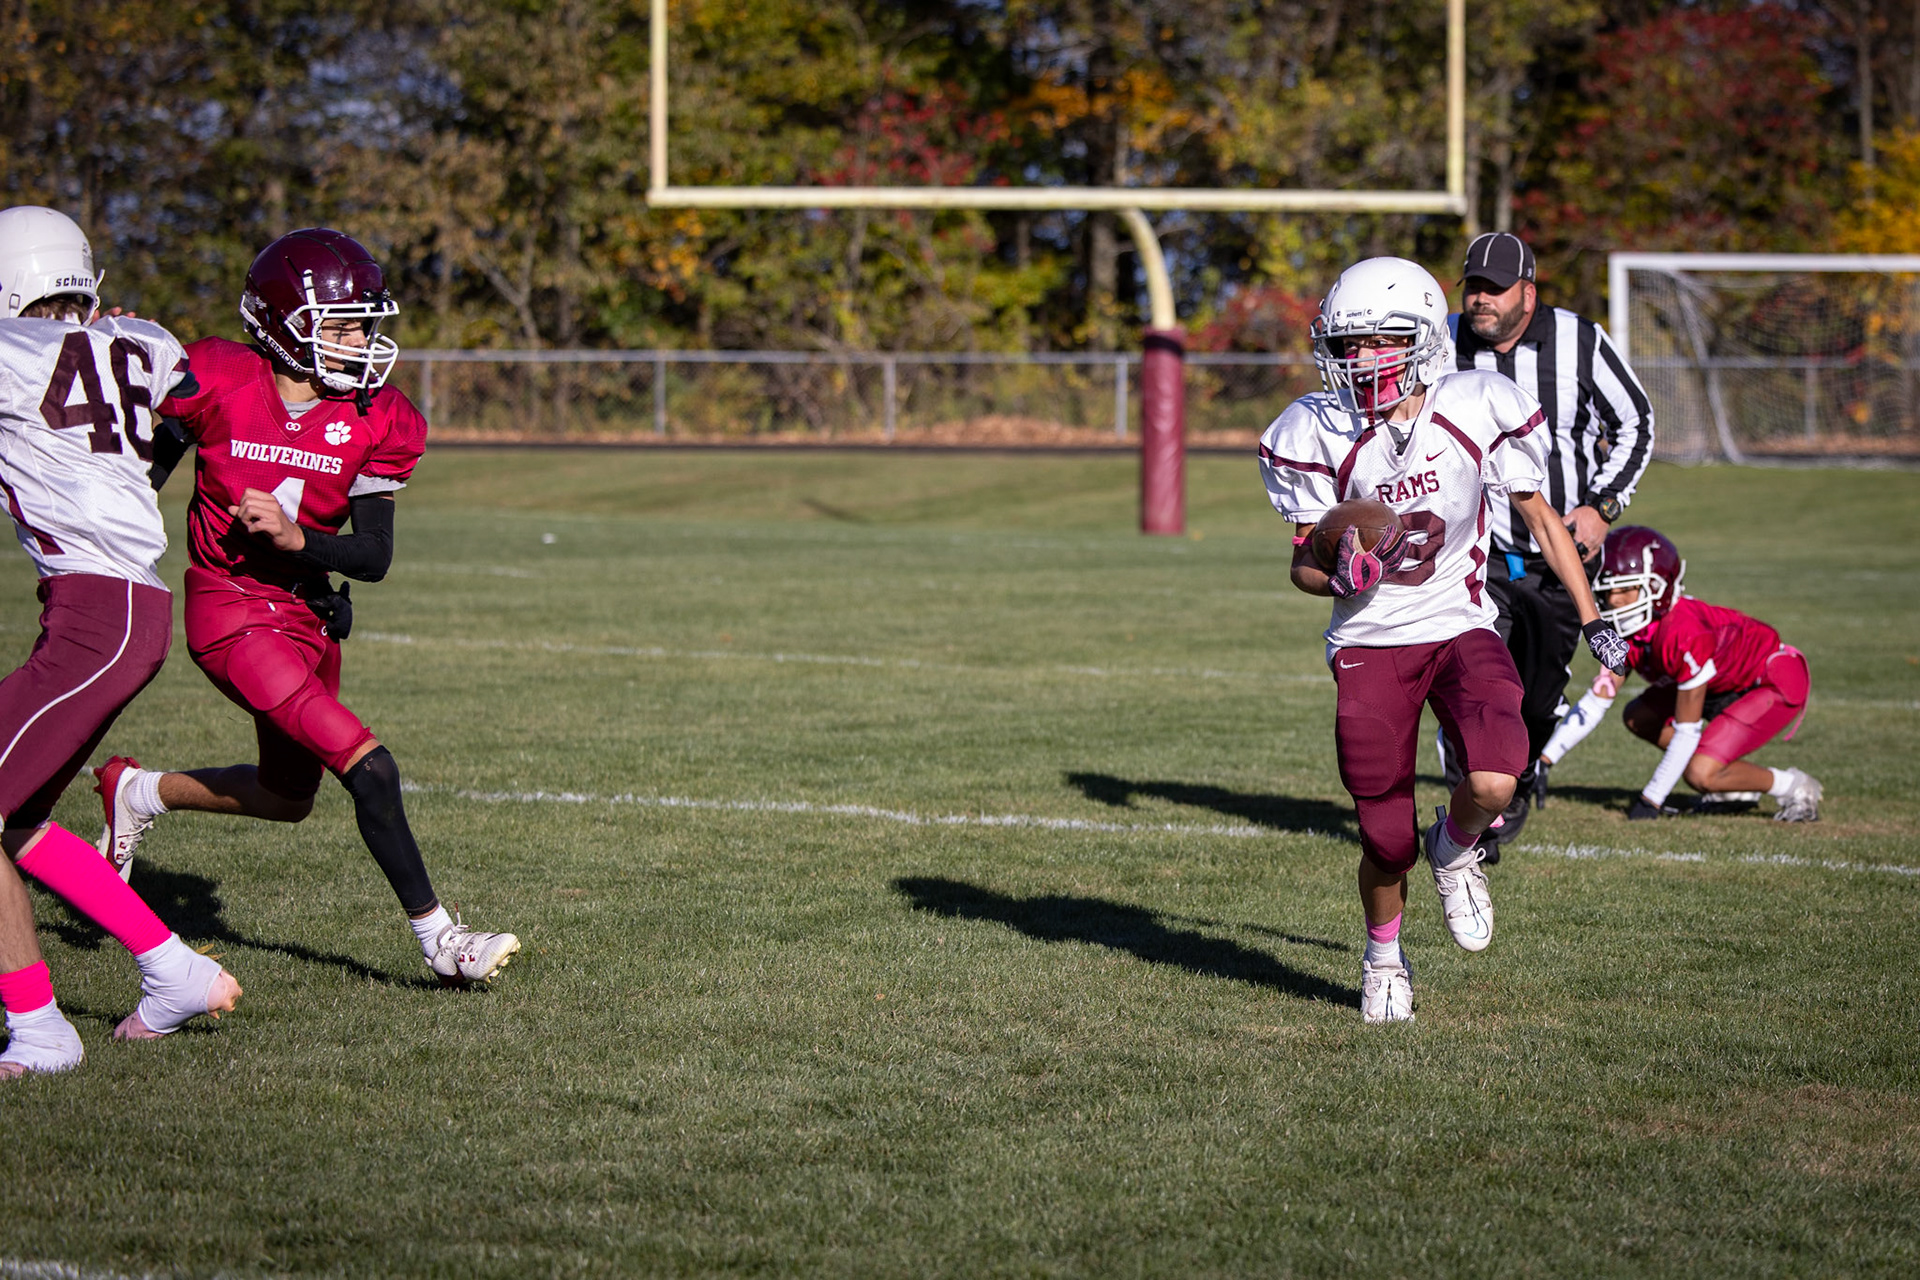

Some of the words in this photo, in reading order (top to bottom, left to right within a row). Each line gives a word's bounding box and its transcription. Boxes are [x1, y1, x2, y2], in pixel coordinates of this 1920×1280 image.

[55, 274, 93, 288] schutt
[39, 331, 154, 462] 46
[230, 439, 344, 475] WOLVERINES
[1375, 470, 1441, 504] RAMS
[1683, 650, 1702, 677] 1
